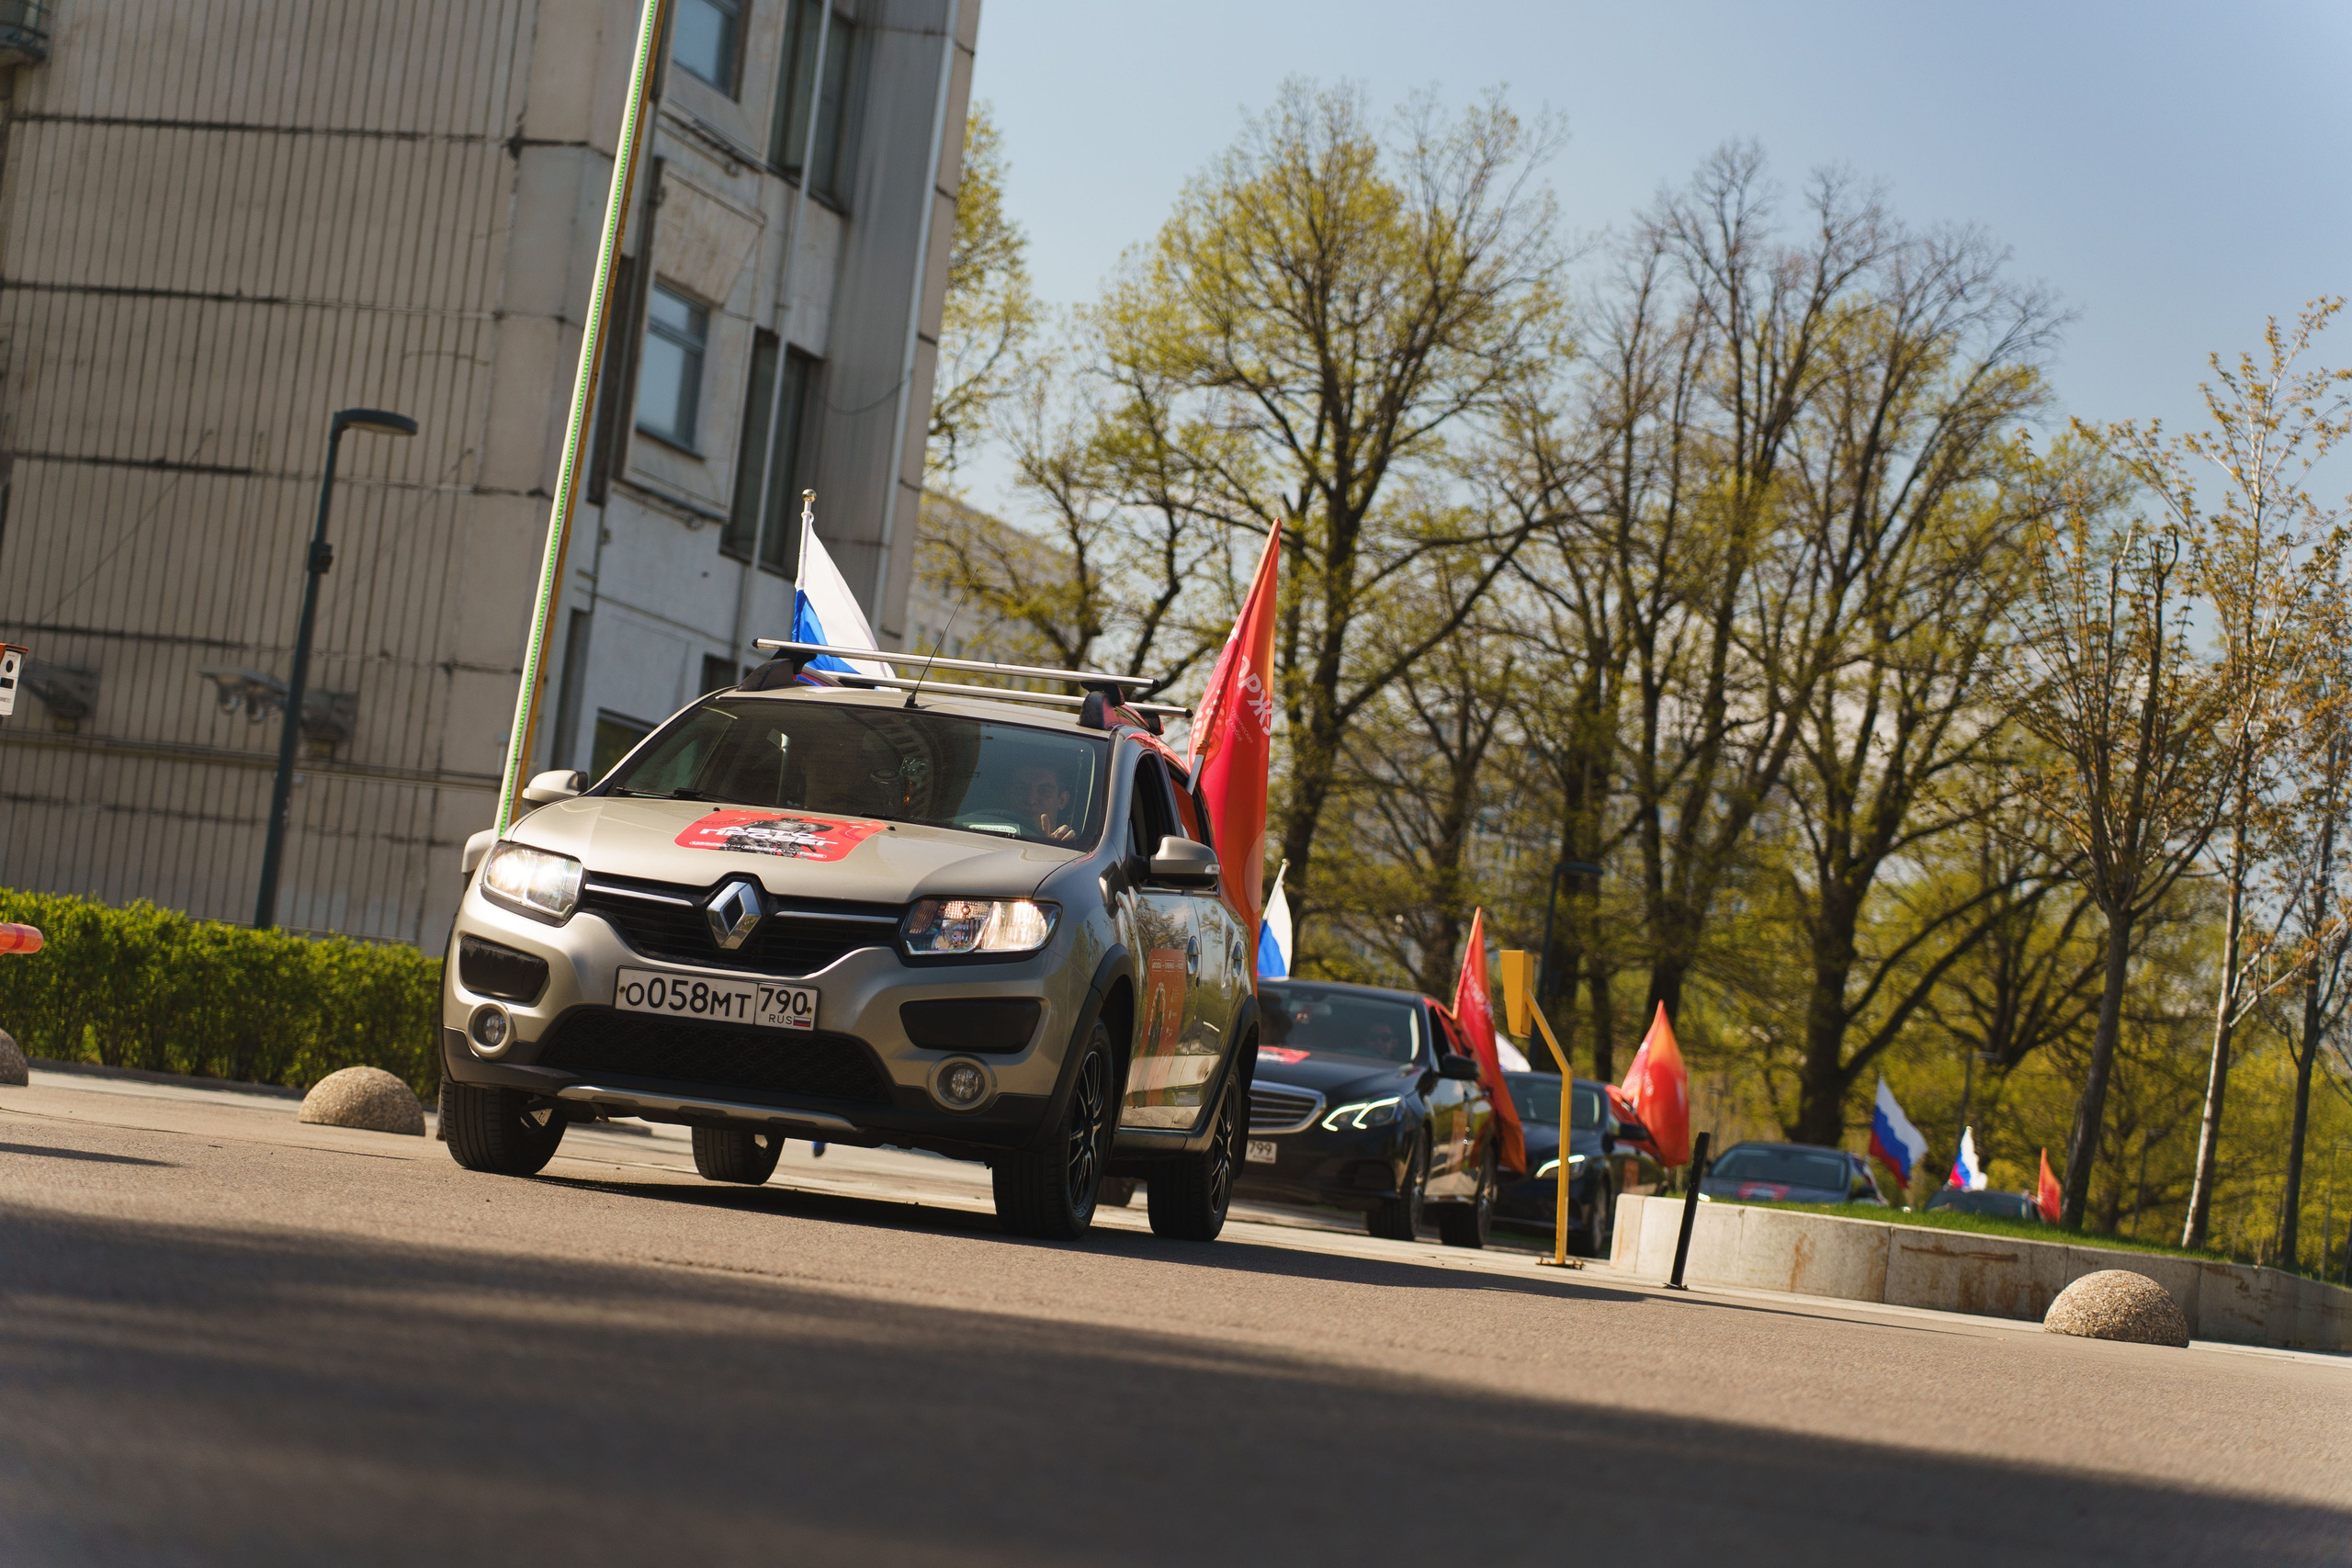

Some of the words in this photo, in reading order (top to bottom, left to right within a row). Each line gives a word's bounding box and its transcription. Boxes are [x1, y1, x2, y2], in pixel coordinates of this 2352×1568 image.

[699, 829, 838, 847] ПРОБЕГ
[760, 987, 808, 1015] 790
[769, 1014, 793, 1025] RUS
[1249, 1140, 1272, 1156] 799
